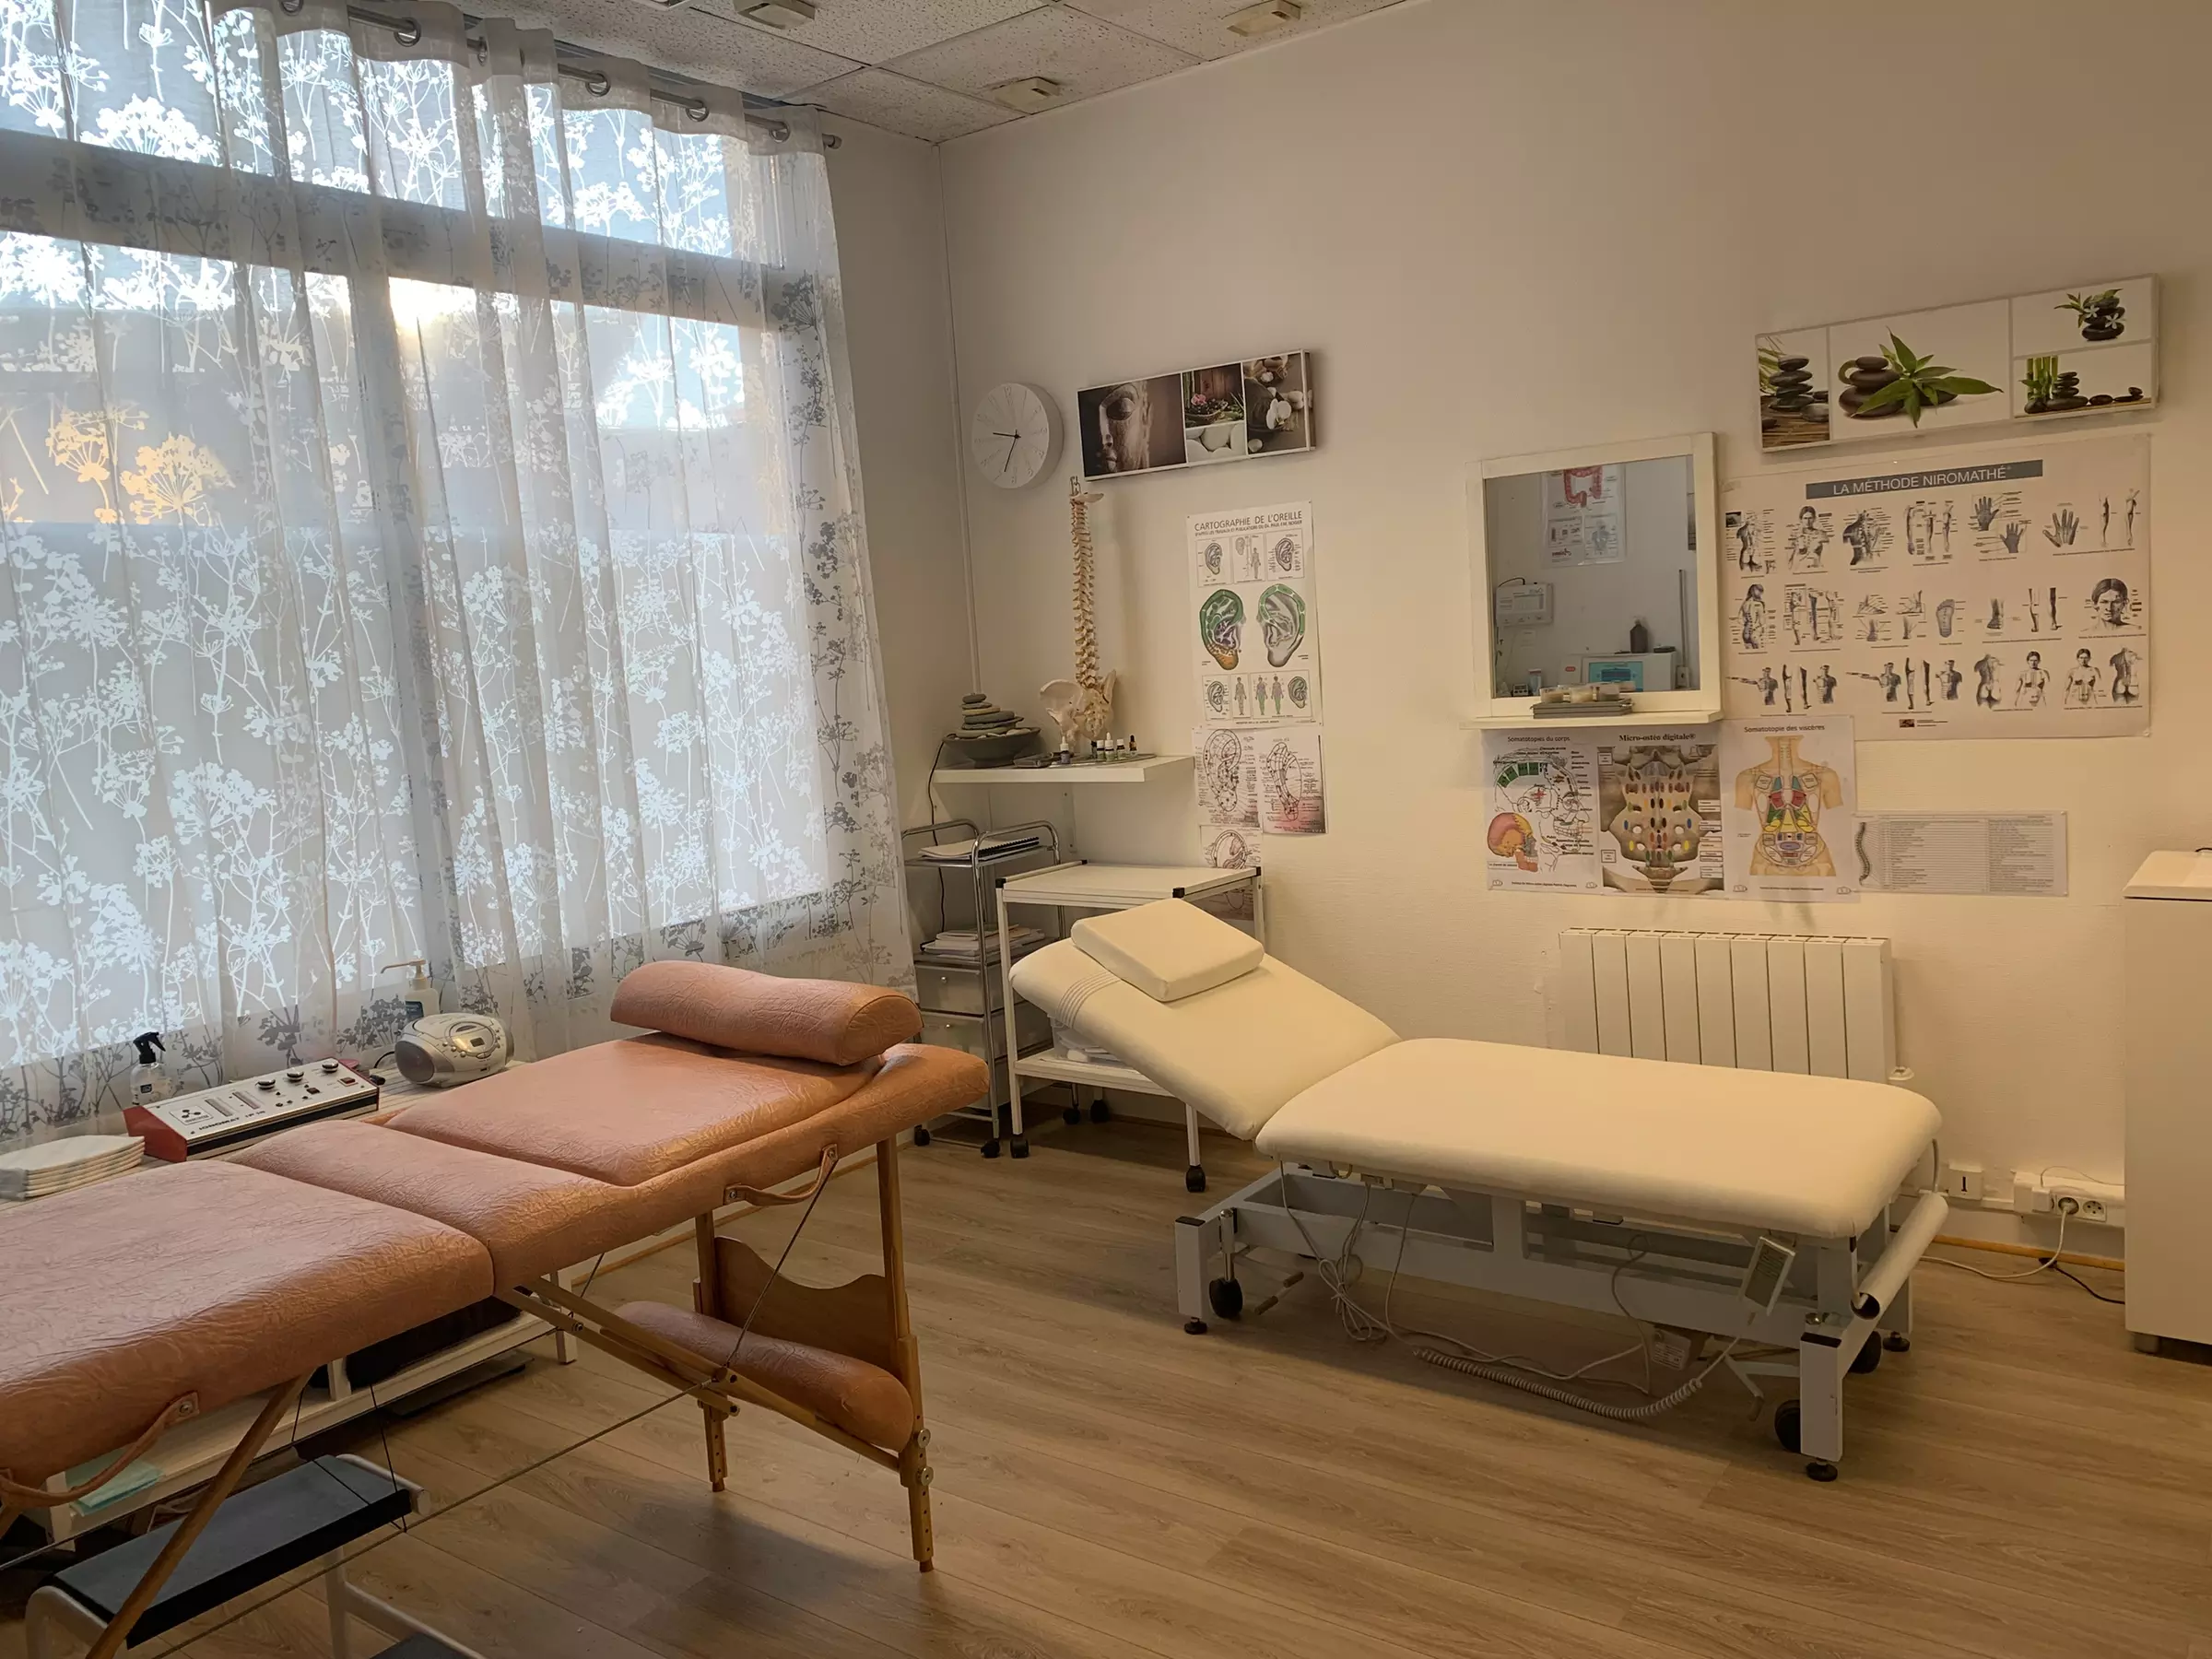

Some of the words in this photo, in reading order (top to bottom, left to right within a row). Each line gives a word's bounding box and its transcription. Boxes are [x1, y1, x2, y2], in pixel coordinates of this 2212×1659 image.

[1833, 484, 1850, 496] LA
[1853, 476, 1919, 494] MÉTHODE
[1194, 516, 1251, 532] CARTOGRAPHIE
[1254, 515, 1265, 524] DE
[1267, 511, 1302, 523] L'OREILLE
